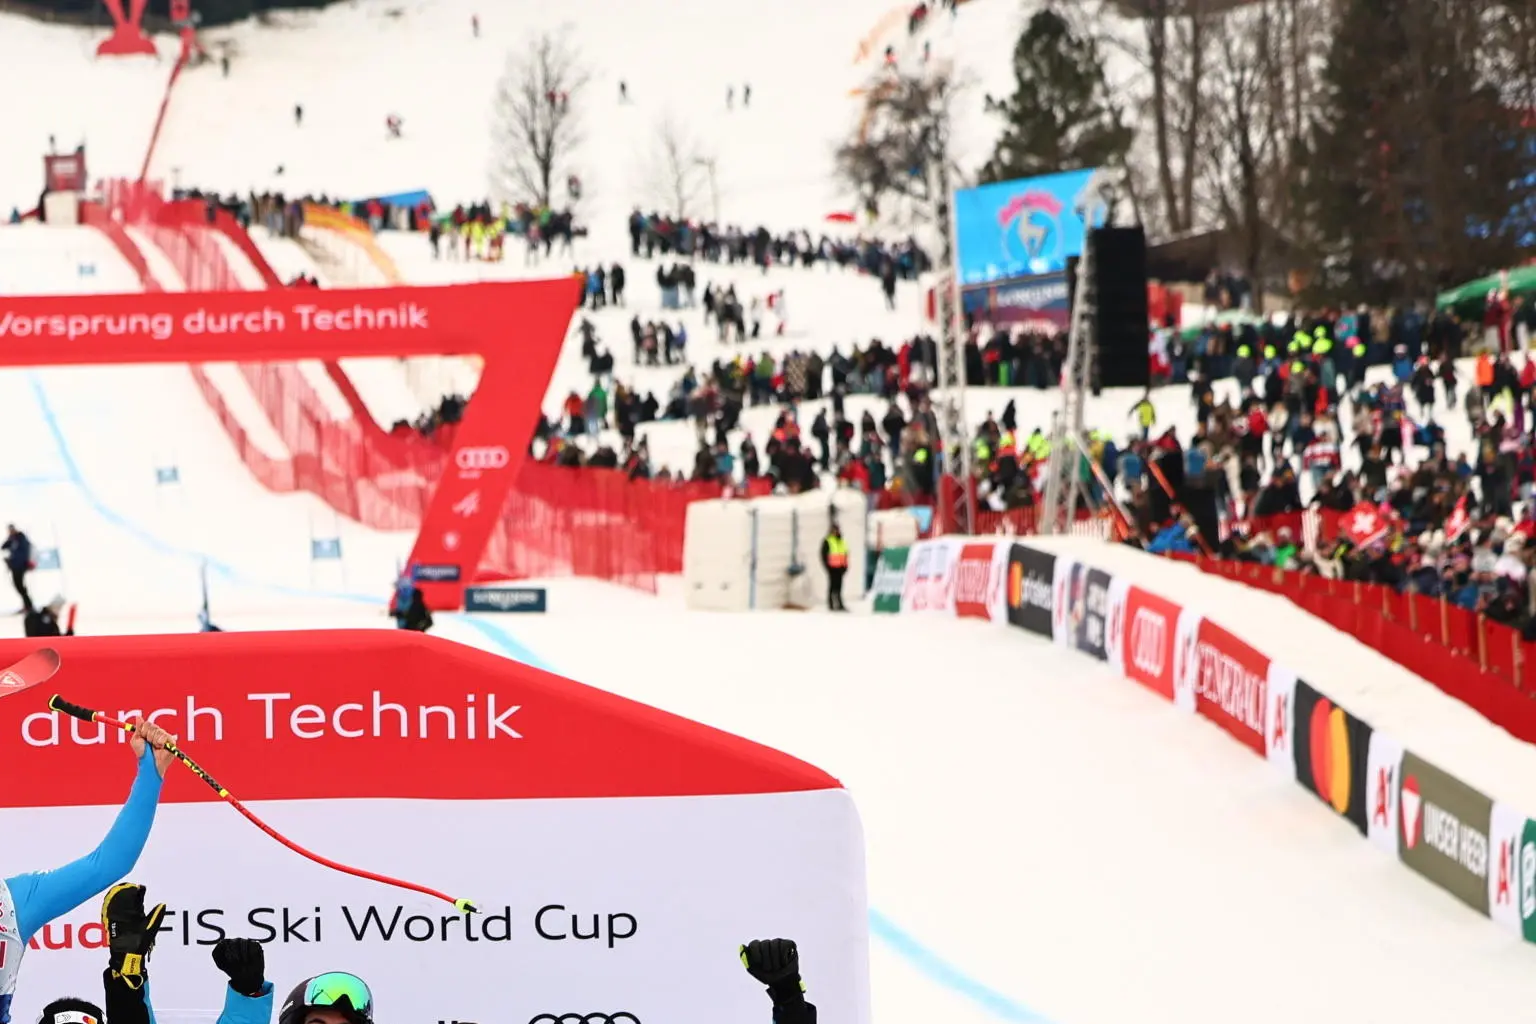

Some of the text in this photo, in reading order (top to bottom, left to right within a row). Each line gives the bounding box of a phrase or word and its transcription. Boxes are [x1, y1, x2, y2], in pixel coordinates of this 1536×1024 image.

[183, 304, 285, 335] durch
[292, 302, 430, 331] Technik
[1194, 642, 1267, 736] GENERALI
[247, 690, 525, 743] Technik
[1423, 800, 1487, 878] UNSER HEER
[247, 905, 321, 945] Ski
[341, 903, 513, 943] World
[534, 902, 639, 949] Cup
